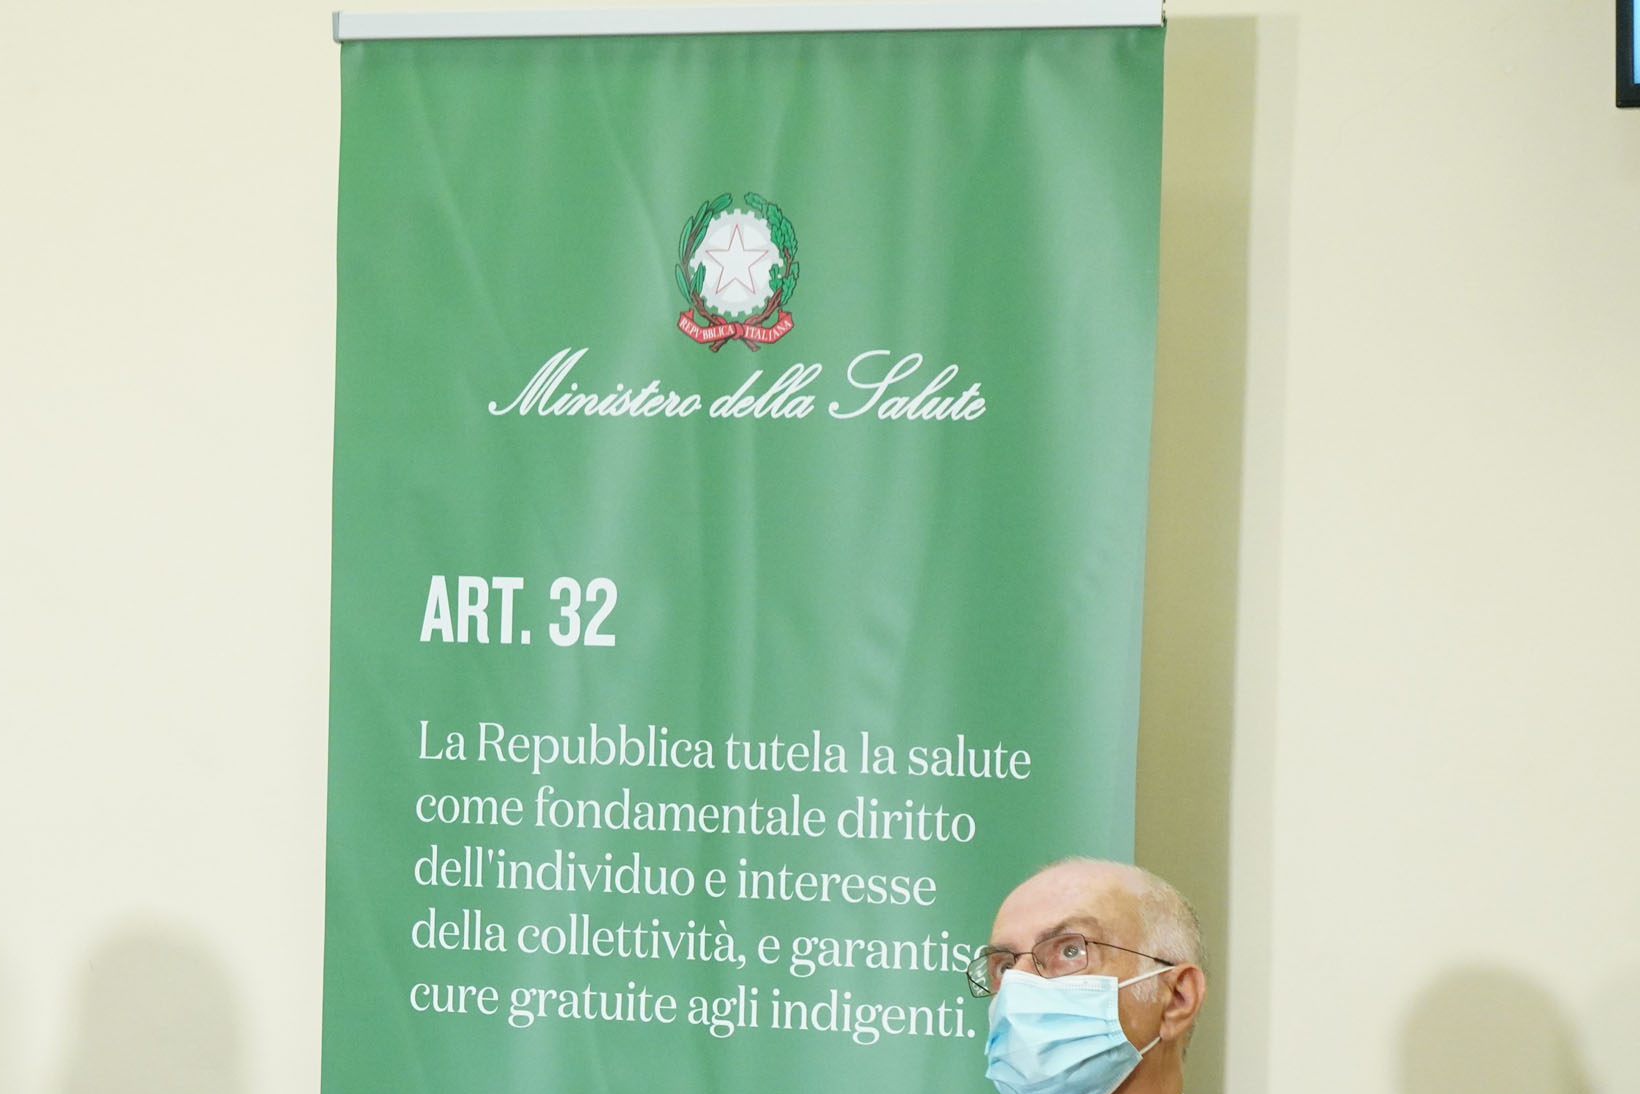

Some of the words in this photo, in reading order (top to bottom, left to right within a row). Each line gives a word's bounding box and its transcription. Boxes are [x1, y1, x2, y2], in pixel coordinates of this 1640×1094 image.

[744, 319, 793, 341] ITALIANA
[488, 348, 701, 417] Ministero
[710, 363, 822, 418] della
[828, 350, 986, 420] Salute
[420, 575, 530, 644] ART.
[549, 577, 617, 646] 32
[419, 720, 466, 760] La
[478, 723, 715, 774] Repubblica
[726, 730, 848, 773] tutela
[860, 731, 896, 774] la
[908, 734, 1031, 779] salute
[416, 795, 523, 826] come
[536, 785, 825, 837] fondamentale
[837, 796, 975, 842] diritto
[415, 845, 694, 896] dell'individuo
[705, 869, 726, 897] e
[738, 858, 936, 905] interesse
[412, 908, 507, 952] della
[518, 913, 746, 969] collettività,
[758, 936, 780, 964] e
[410, 984, 498, 1014] cure
[508, 981, 676, 1028] gratuite
[688, 985, 758, 1038] agli
[772, 989, 975, 1045] indigenti.
